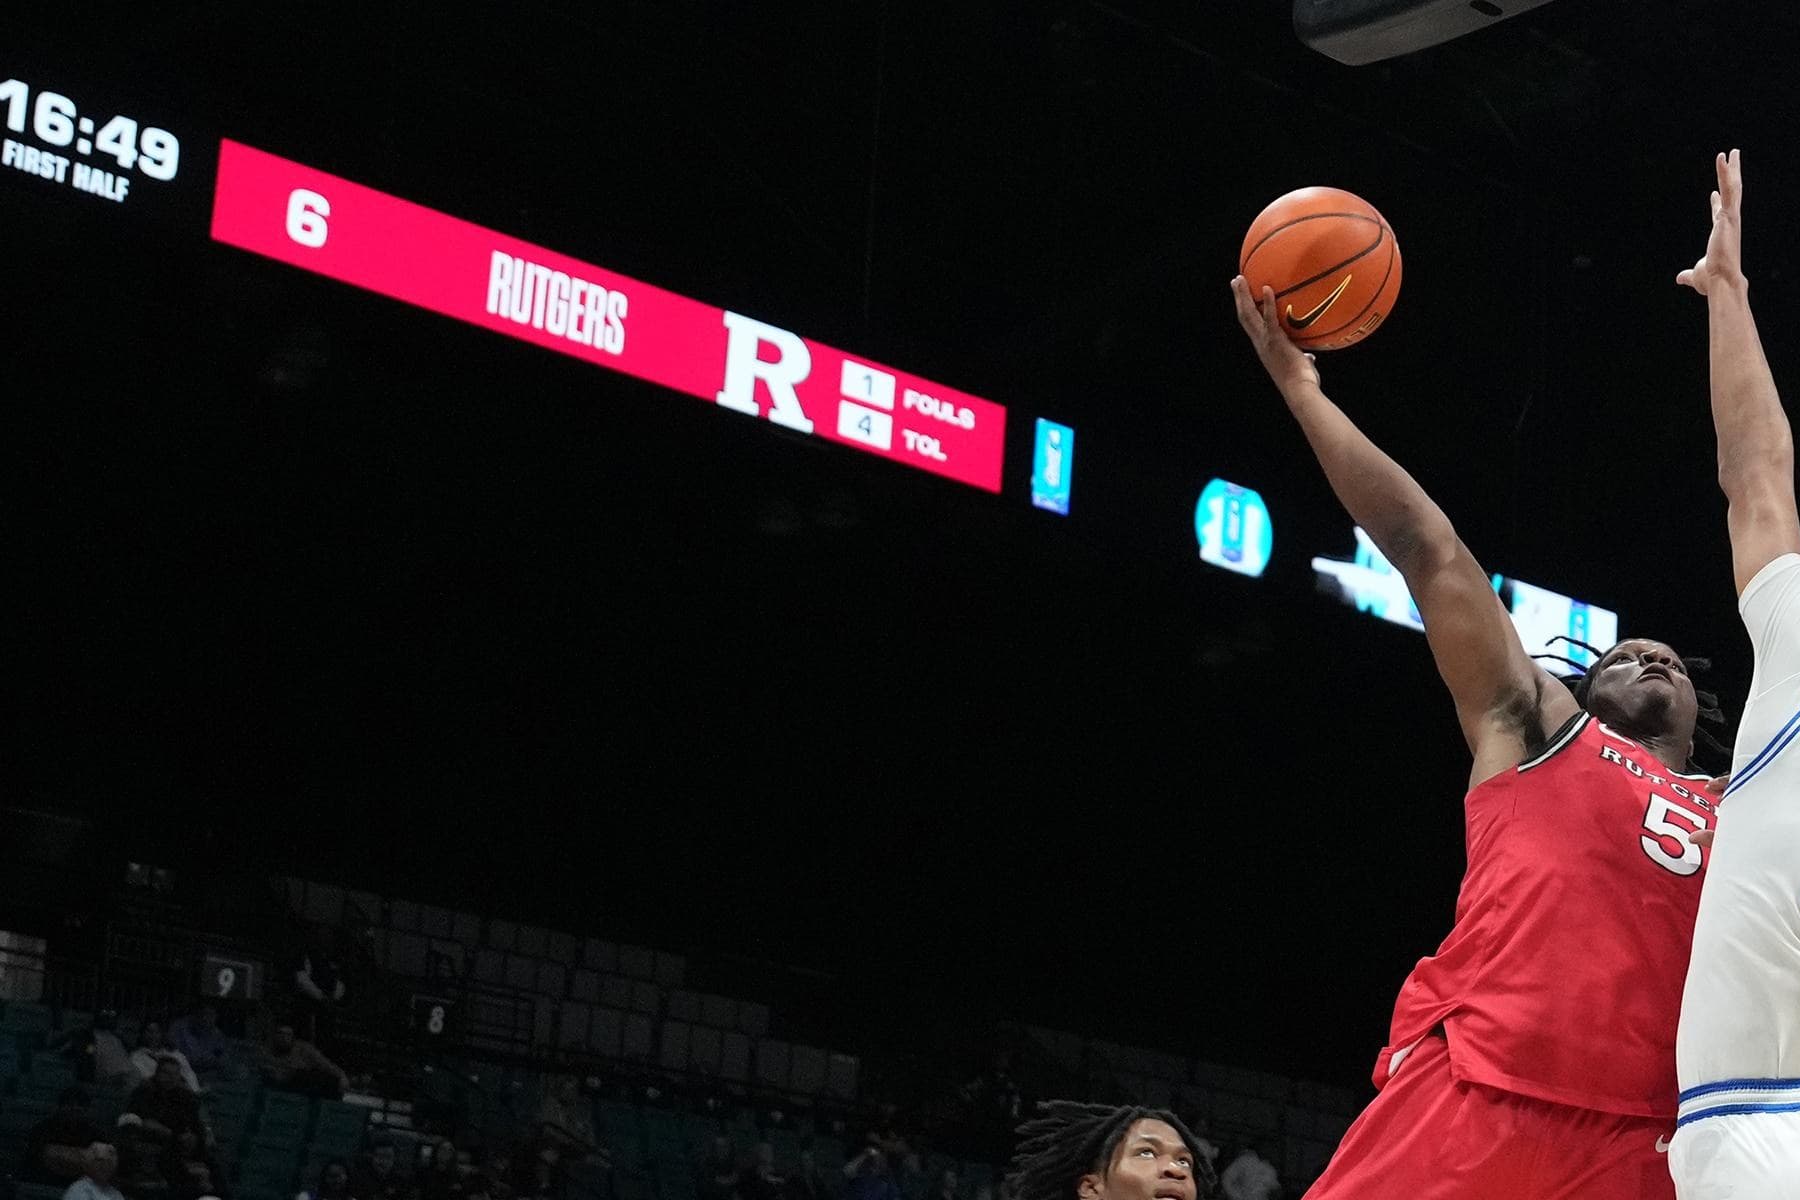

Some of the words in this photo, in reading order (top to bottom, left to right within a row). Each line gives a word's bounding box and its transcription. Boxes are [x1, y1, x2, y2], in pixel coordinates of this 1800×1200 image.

[0, 78, 181, 182] 16:49
[2, 138, 70, 184] FIRST
[72, 162, 130, 203] HALF
[285, 188, 331, 248] 6
[486, 249, 628, 356] RUTGERS
[716, 310, 814, 433] R
[863, 374, 875, 397] 1
[902, 388, 976, 431] FOULS
[857, 412, 873, 437] 4
[901, 429, 948, 462] TOL
[1600, 745, 1721, 818] RUTGE
[1640, 792, 1709, 876] 5
[217, 967, 236, 997] 9
[428, 1005, 446, 1034] 8
